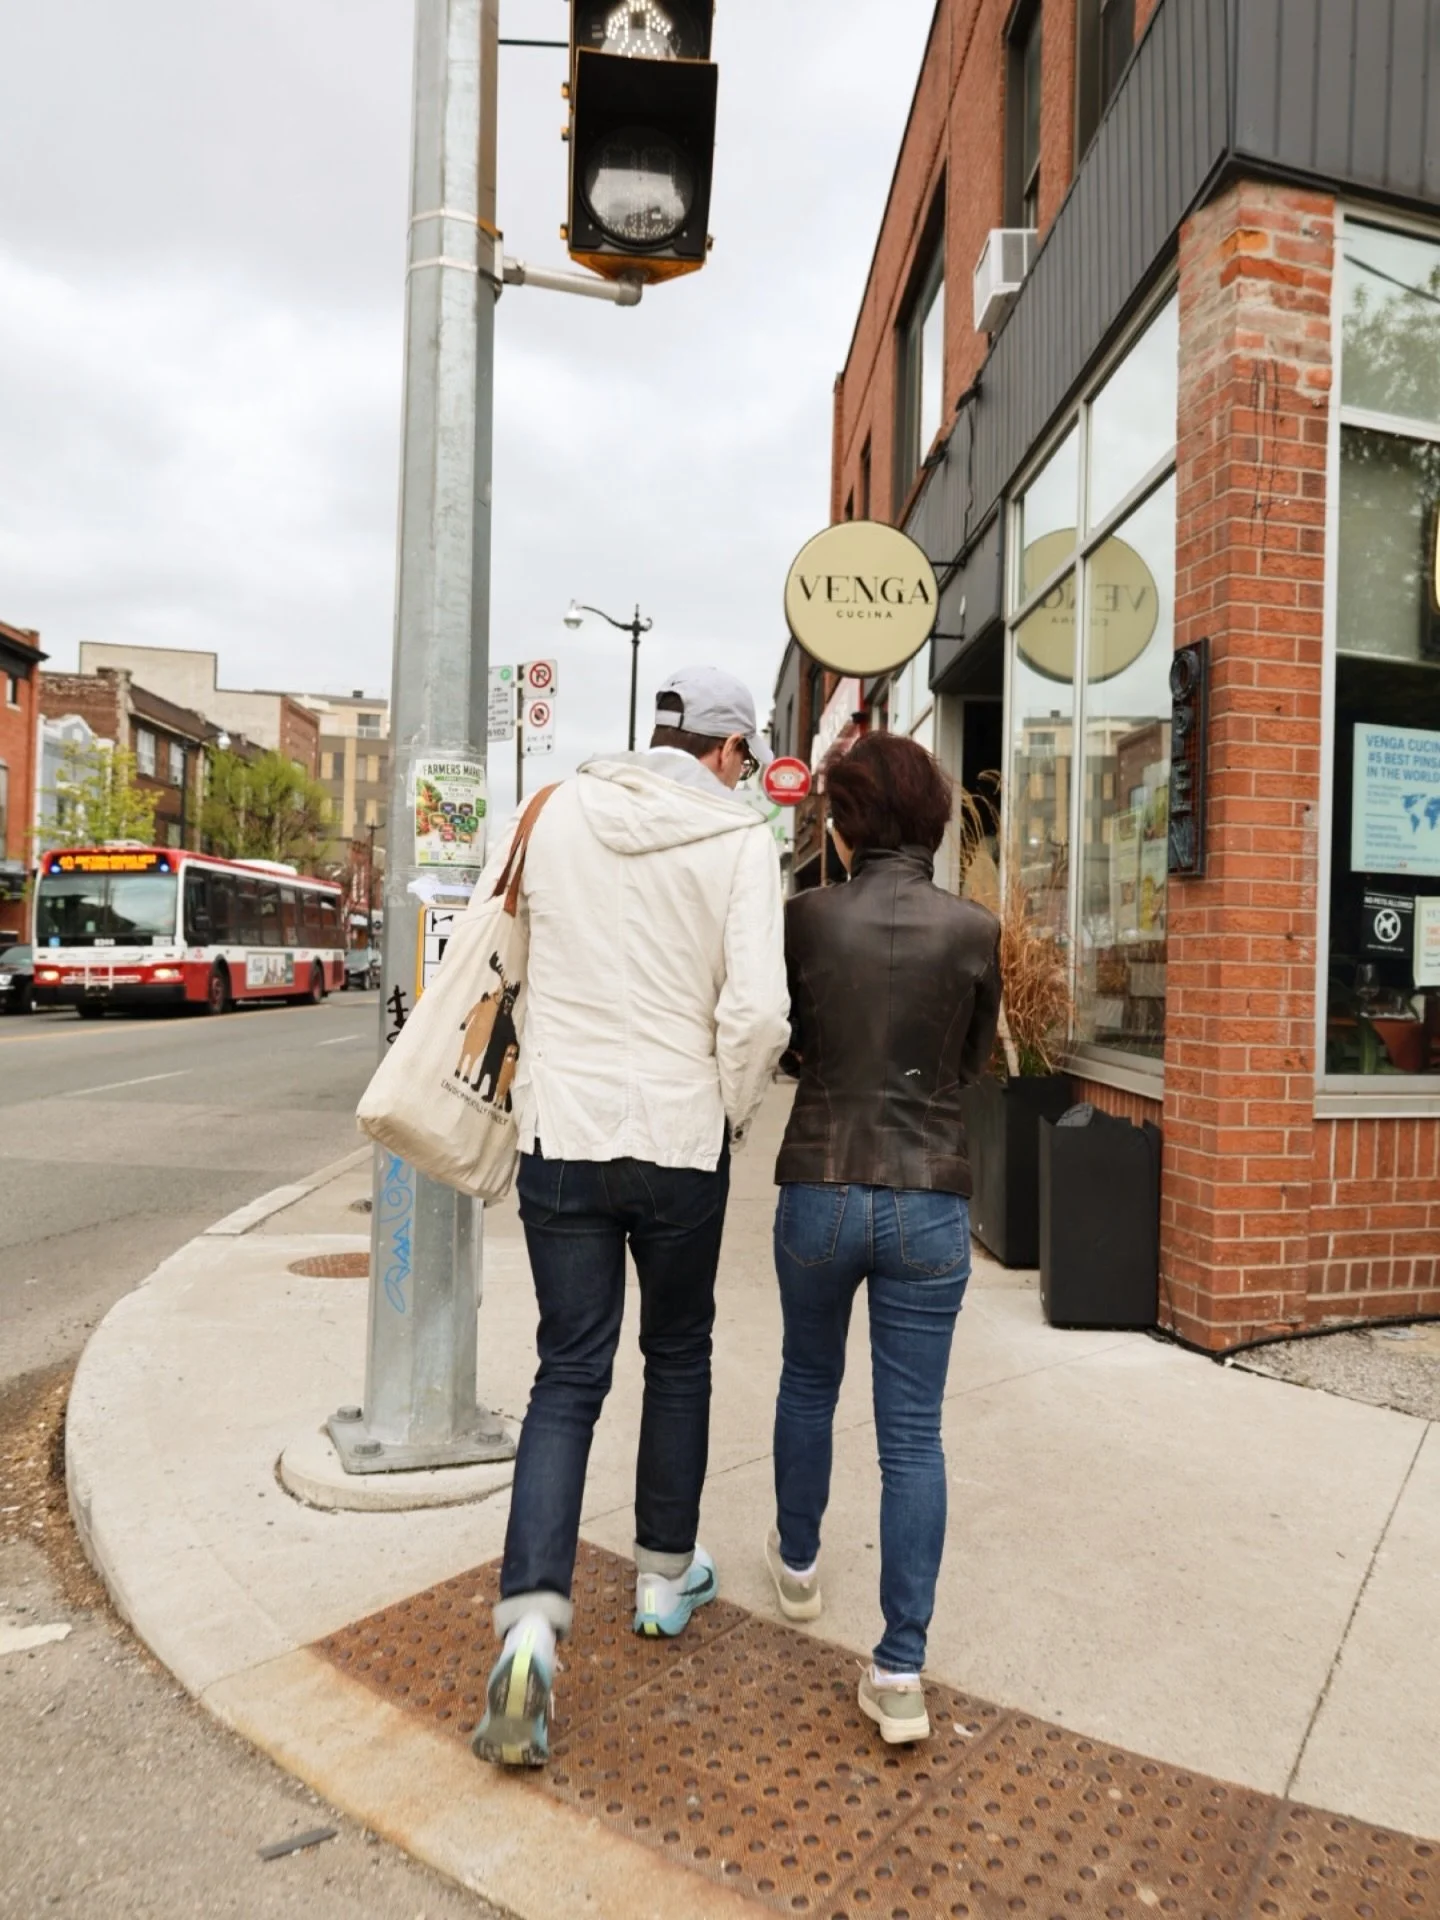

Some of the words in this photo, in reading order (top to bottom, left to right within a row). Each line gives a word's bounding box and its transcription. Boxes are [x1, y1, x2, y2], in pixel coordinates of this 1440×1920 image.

[794, 574, 933, 605] VENGA
[836, 609, 893, 619] CUCINA
[1366, 734, 1404, 749] VENGA
[1384, 752, 1410, 765] BEST
[1413, 755, 1440, 769] PINS
[423, 763, 461, 776] FARMERS
[1366, 766, 1377, 778] IN
[1380, 766, 1400, 780] THE
[1403, 769, 1440, 783] WORLD
